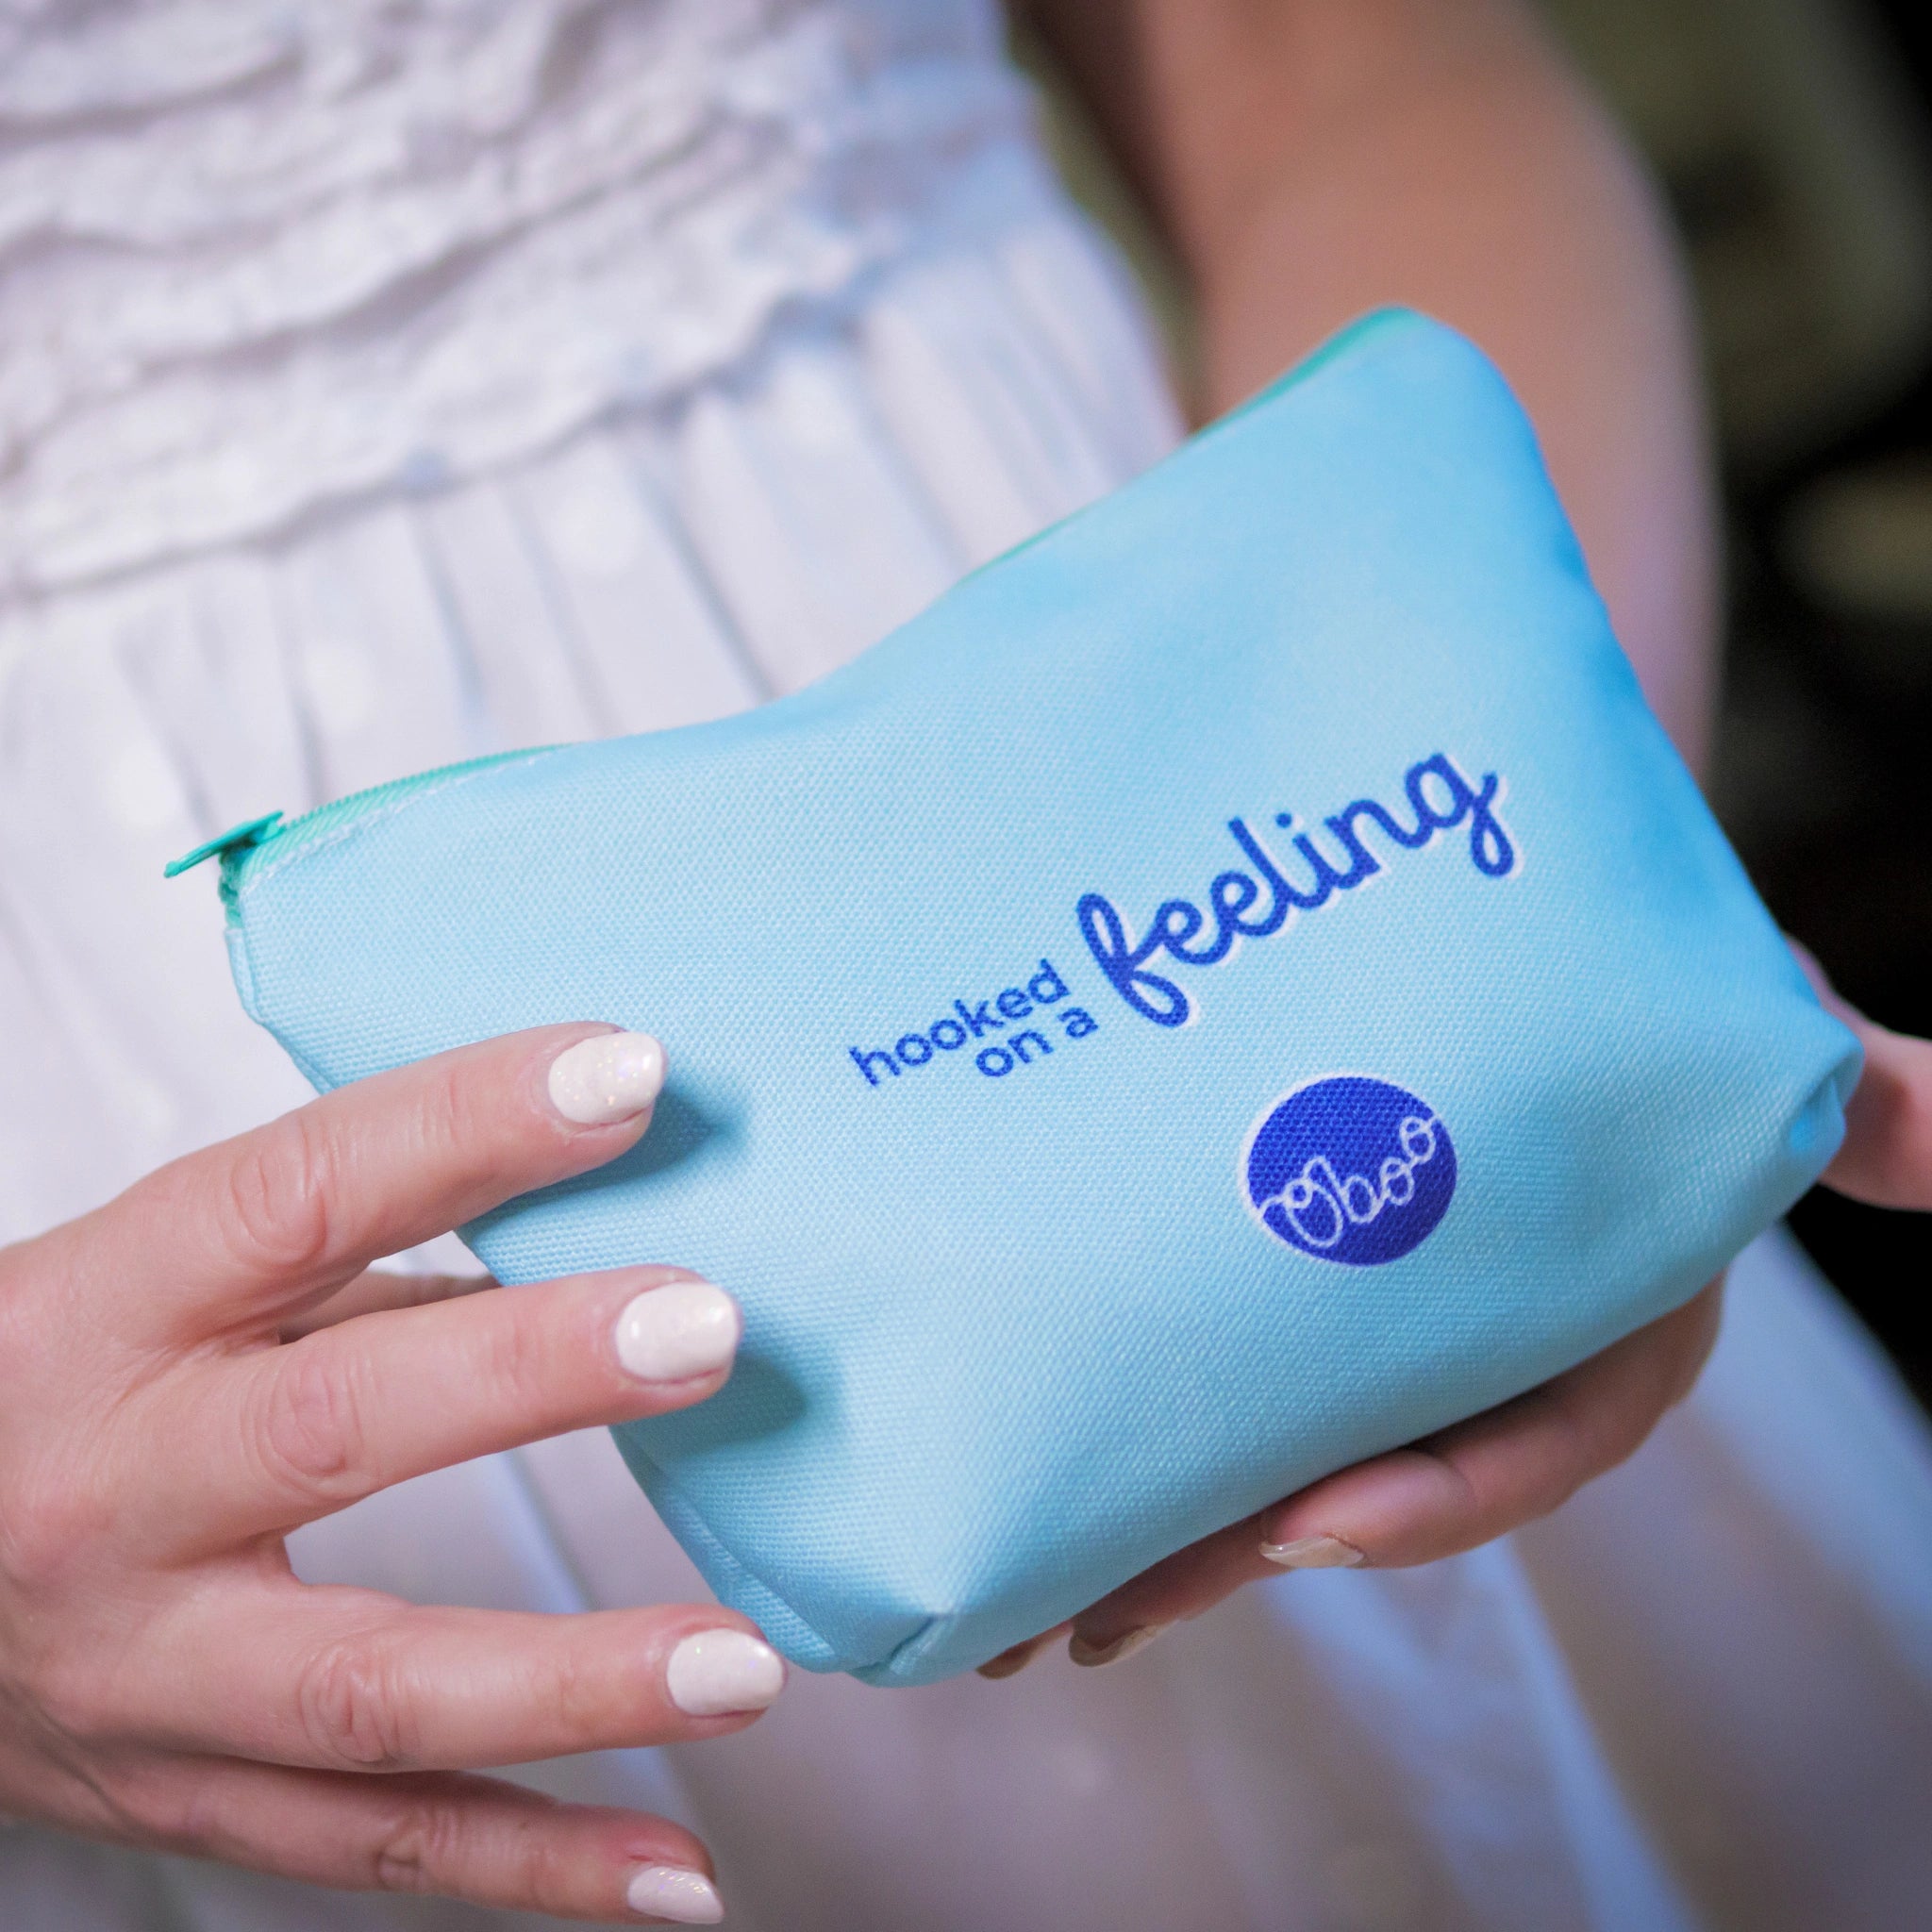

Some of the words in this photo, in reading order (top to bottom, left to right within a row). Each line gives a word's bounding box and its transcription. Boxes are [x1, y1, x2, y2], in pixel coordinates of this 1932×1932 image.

[1076, 752, 1515, 1028] feeling
[848, 957, 1071, 1087] hooked
[974, 1029, 1054, 1078] on
[1058, 1007, 1100, 1040] a
